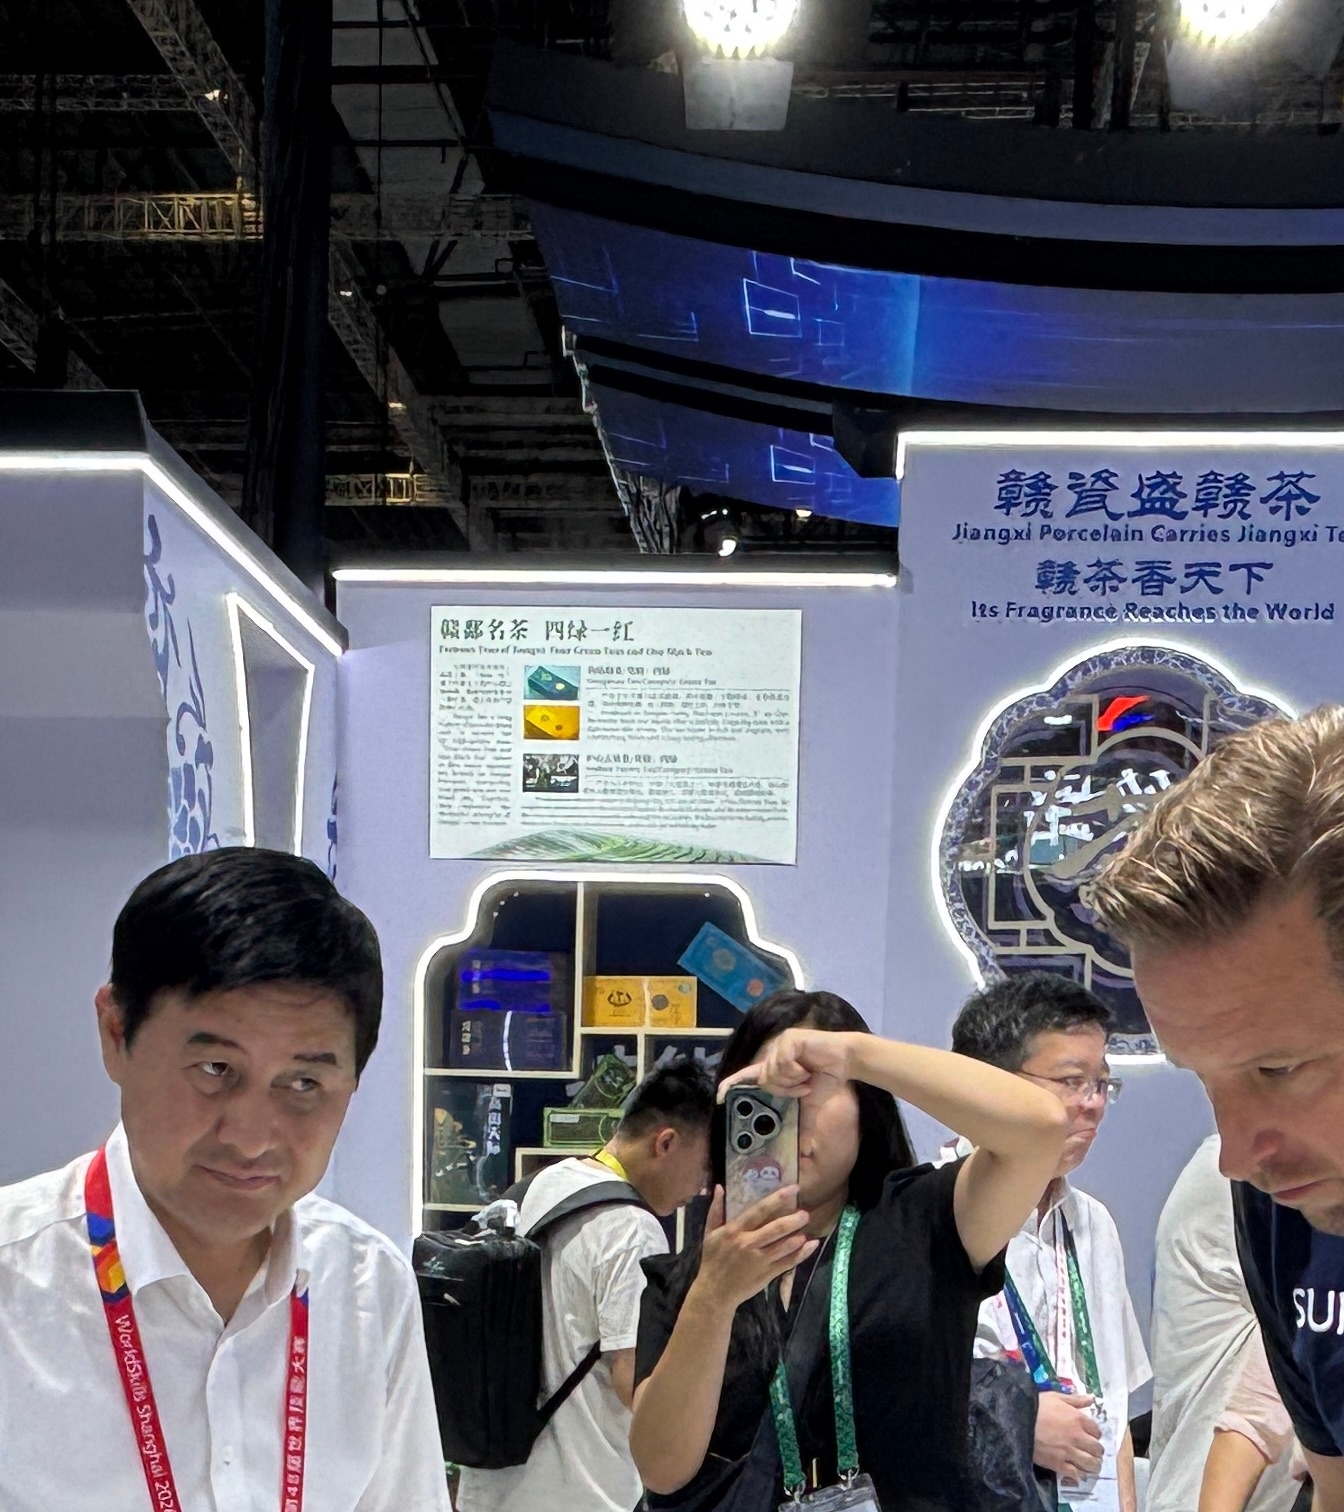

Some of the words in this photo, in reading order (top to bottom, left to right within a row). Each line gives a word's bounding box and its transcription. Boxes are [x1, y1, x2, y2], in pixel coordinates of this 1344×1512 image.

[993, 468, 1322, 521] 赣瓷盛赣茶
[952, 523, 1032, 545] Jiangxi
[1040, 523, 1144, 543] Porcelain
[1151, 523, 1230, 543] Carries
[1237, 523, 1319, 547] Jiangxi
[1034, 557, 1274, 597] 赣茶香天下
[971, 600, 999, 618] Its
[1005, 601, 1117, 623] Fragrance
[1123, 601, 1217, 621] Reaches
[1222, 601, 1259, 620] the
[1265, 601, 1335, 621] World
[113, 1313, 148, 1403] WorldSkills
[136, 1403, 164, 1479] Shanghai
